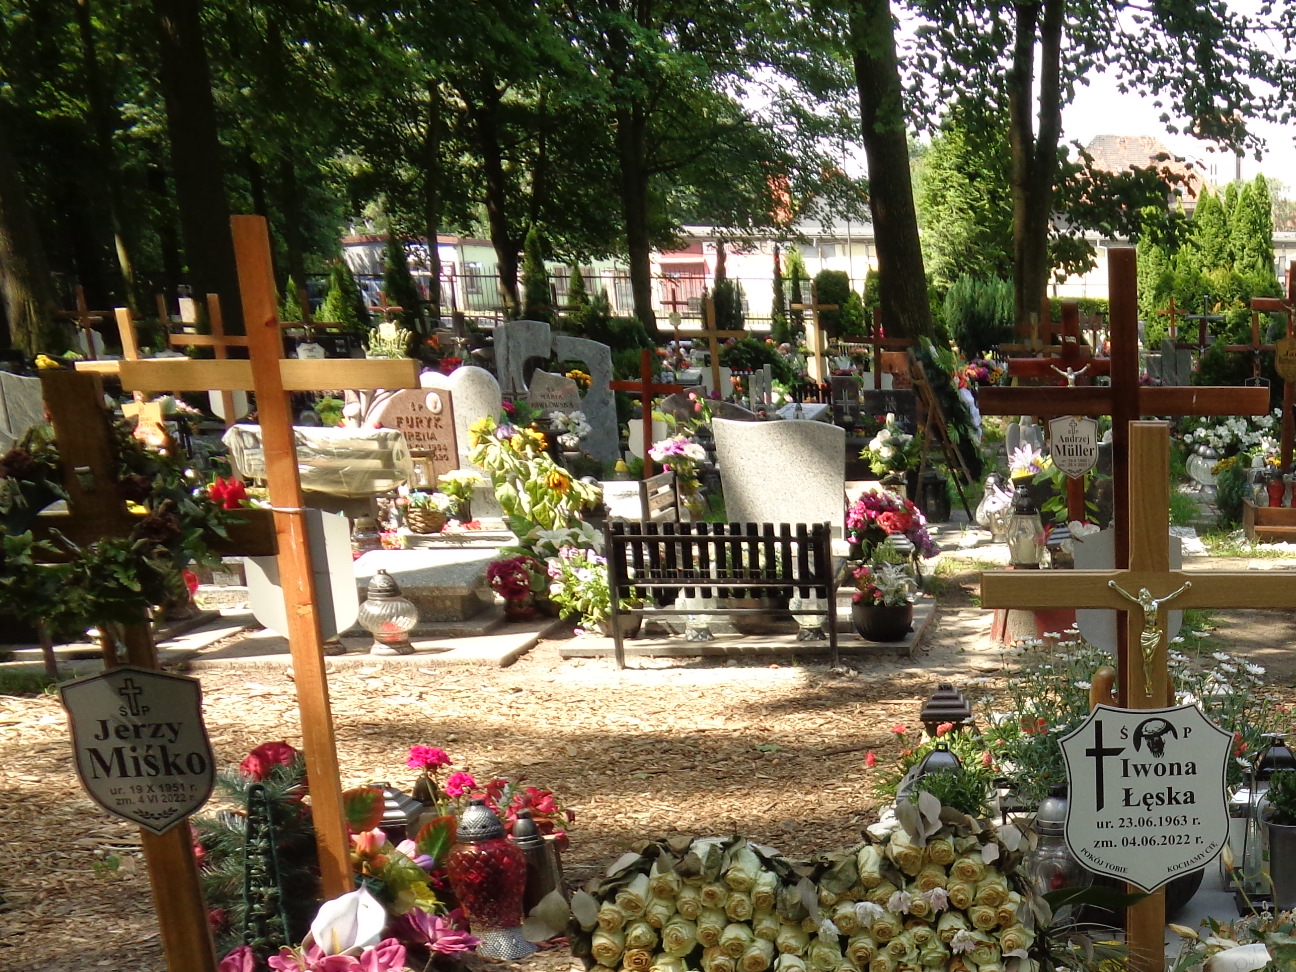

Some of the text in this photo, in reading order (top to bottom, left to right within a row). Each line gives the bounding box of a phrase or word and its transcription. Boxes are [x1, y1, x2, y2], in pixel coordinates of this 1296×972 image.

[1060, 434, 1090, 444] Andrzej
[1054, 444, 1094, 456] Müller
[94, 719, 183, 744] Jerzy
[1120, 725, 1192, 740] Ś P
[84, 744, 207, 780] Miśko
[1120, 758, 1197, 778] Iwona
[110, 786, 126, 796] ur.
[130, 784, 144, 794] 19
[146, 784, 155, 794] X
[158, 783, 186, 793] 1951
[116, 797, 136, 806] zm.
[138, 795, 145, 804] 4
[148, 794, 158, 804] VI
[161, 794, 186, 803] 2022
[1122, 786, 1196, 812] Łęska
[1096, 815, 1200, 829] ur. 23.06.1963 r.
[1093, 834, 1204, 848] zm. 04.06.2022 r.
[1080, 848, 1128, 874] POKÓJ TOBIE
[1166, 852, 1206, 873] KOCHAMY
